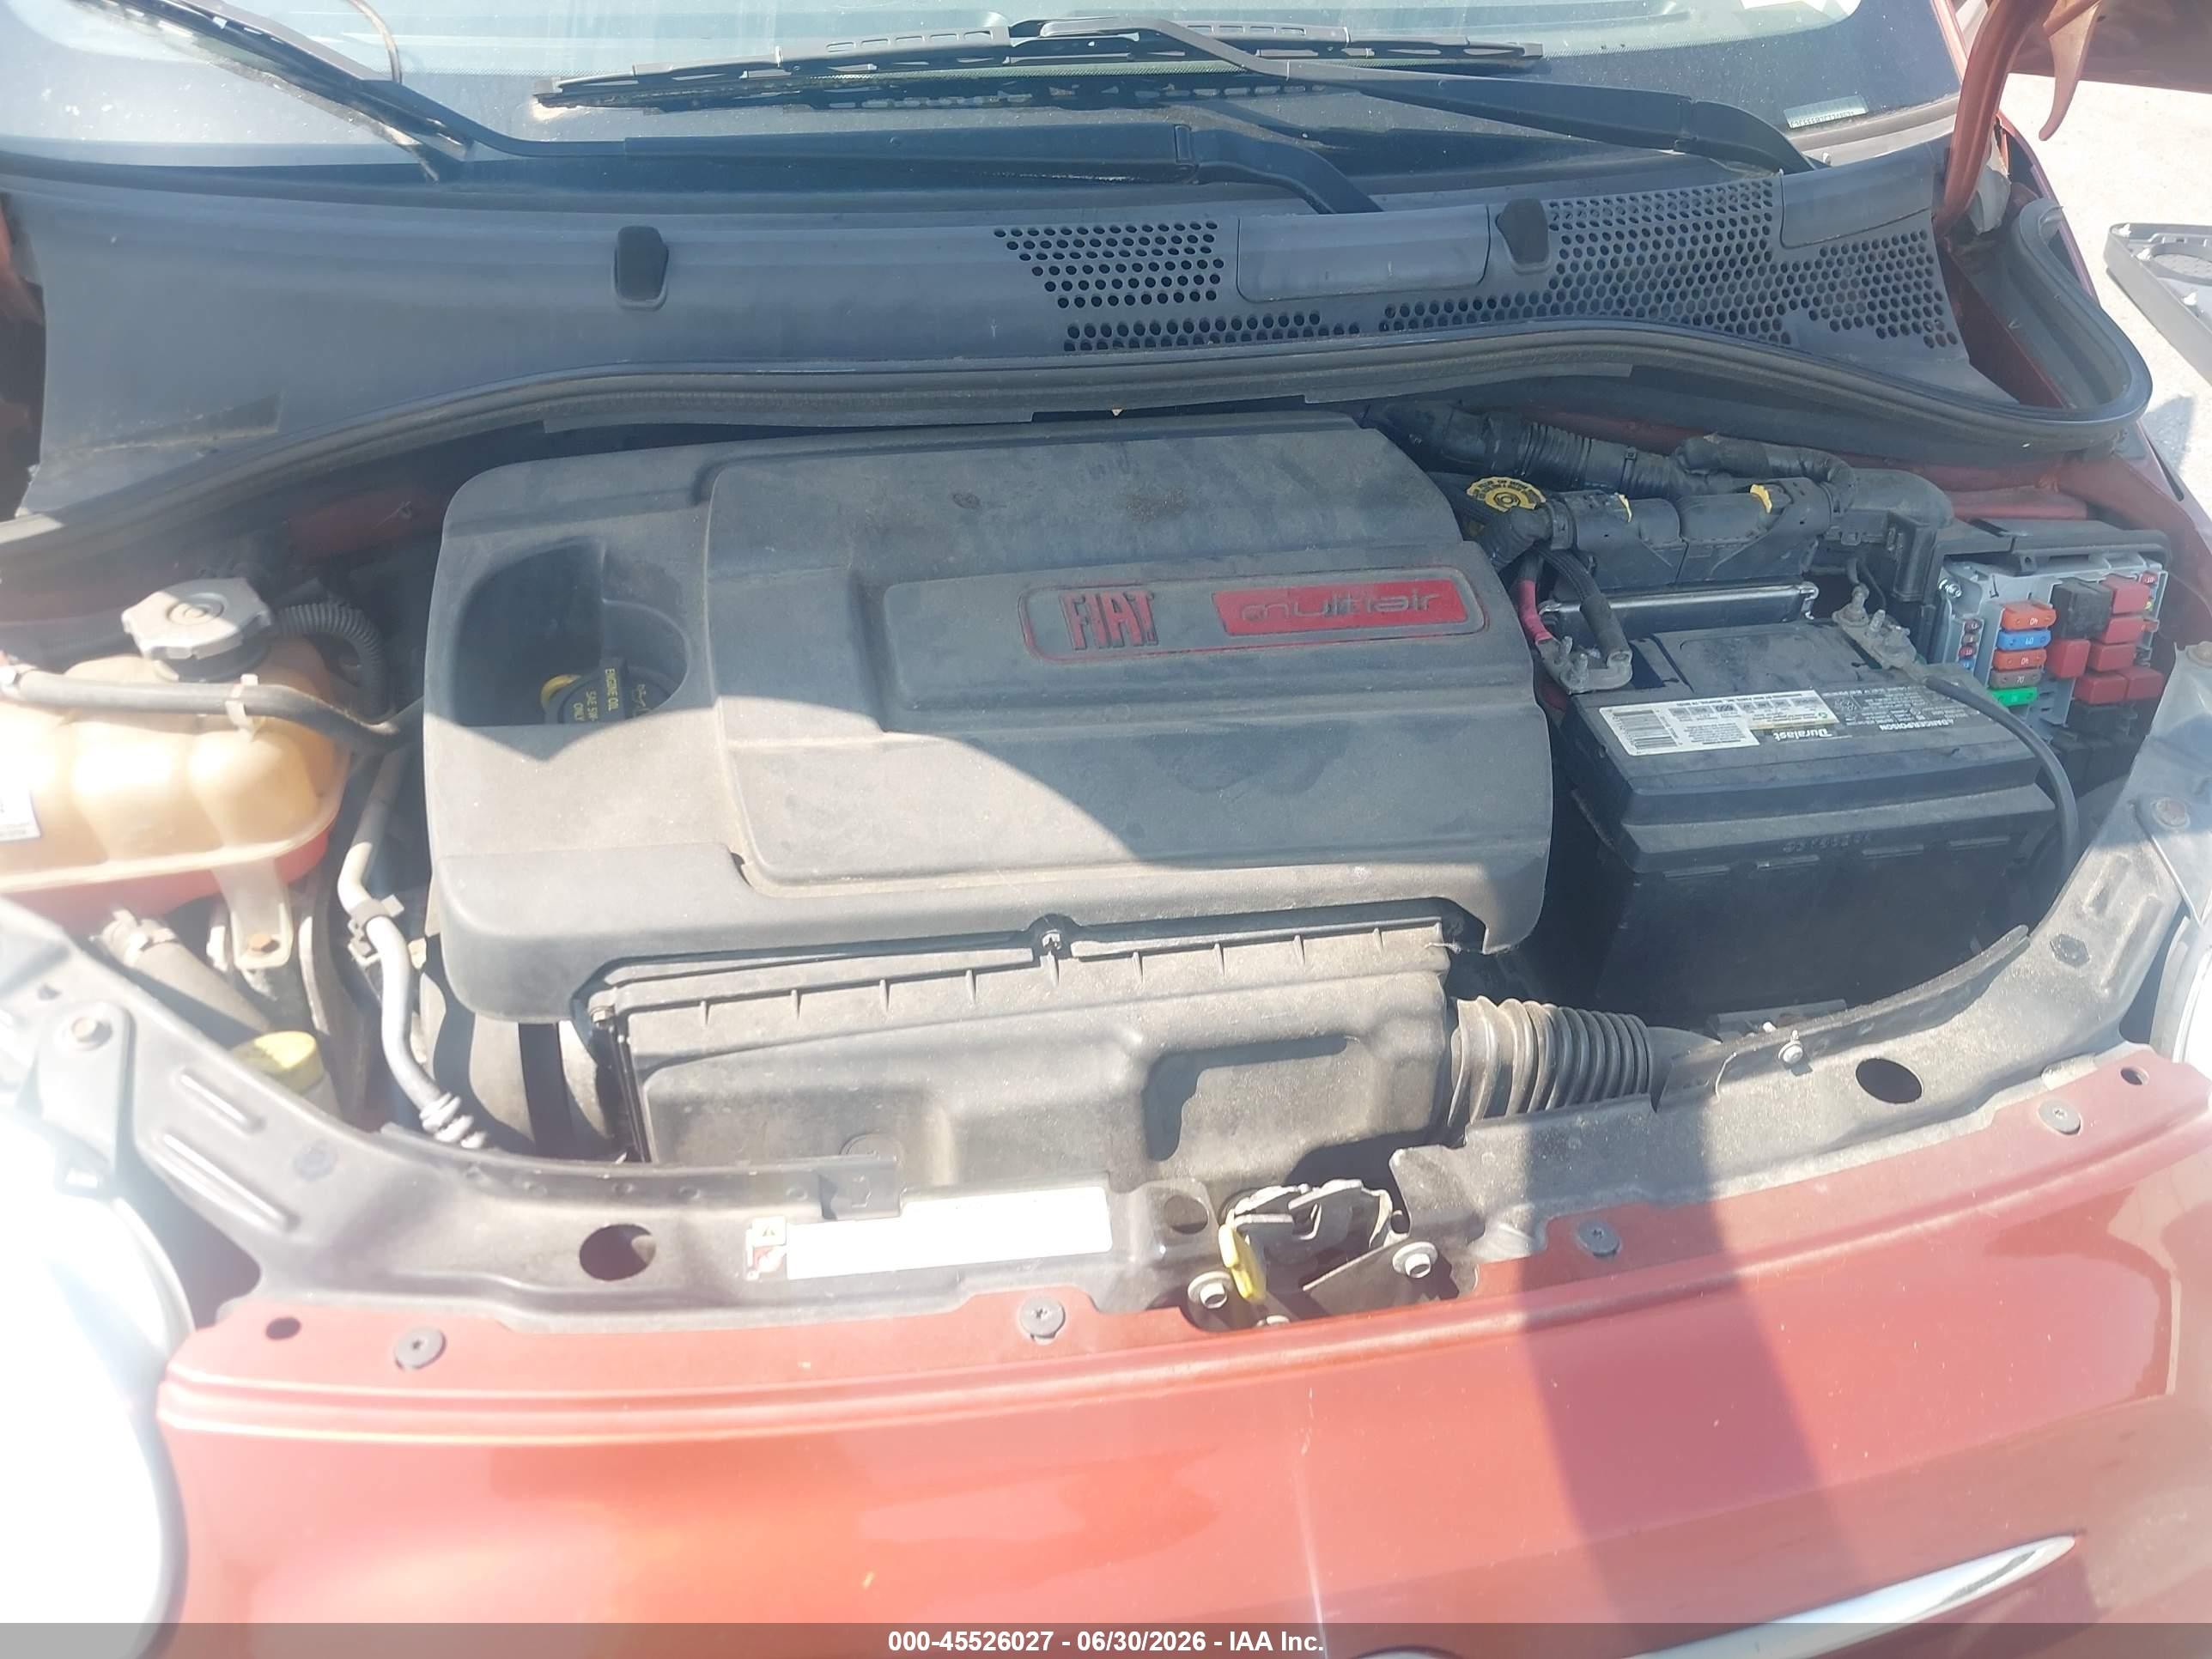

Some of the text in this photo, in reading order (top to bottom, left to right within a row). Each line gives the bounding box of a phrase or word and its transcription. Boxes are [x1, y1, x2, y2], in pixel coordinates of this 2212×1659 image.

[1060, 589, 1158, 651] FIAT
[1242, 587, 1439, 623] multiair
[1772, 728, 1834, 741] Duralast
